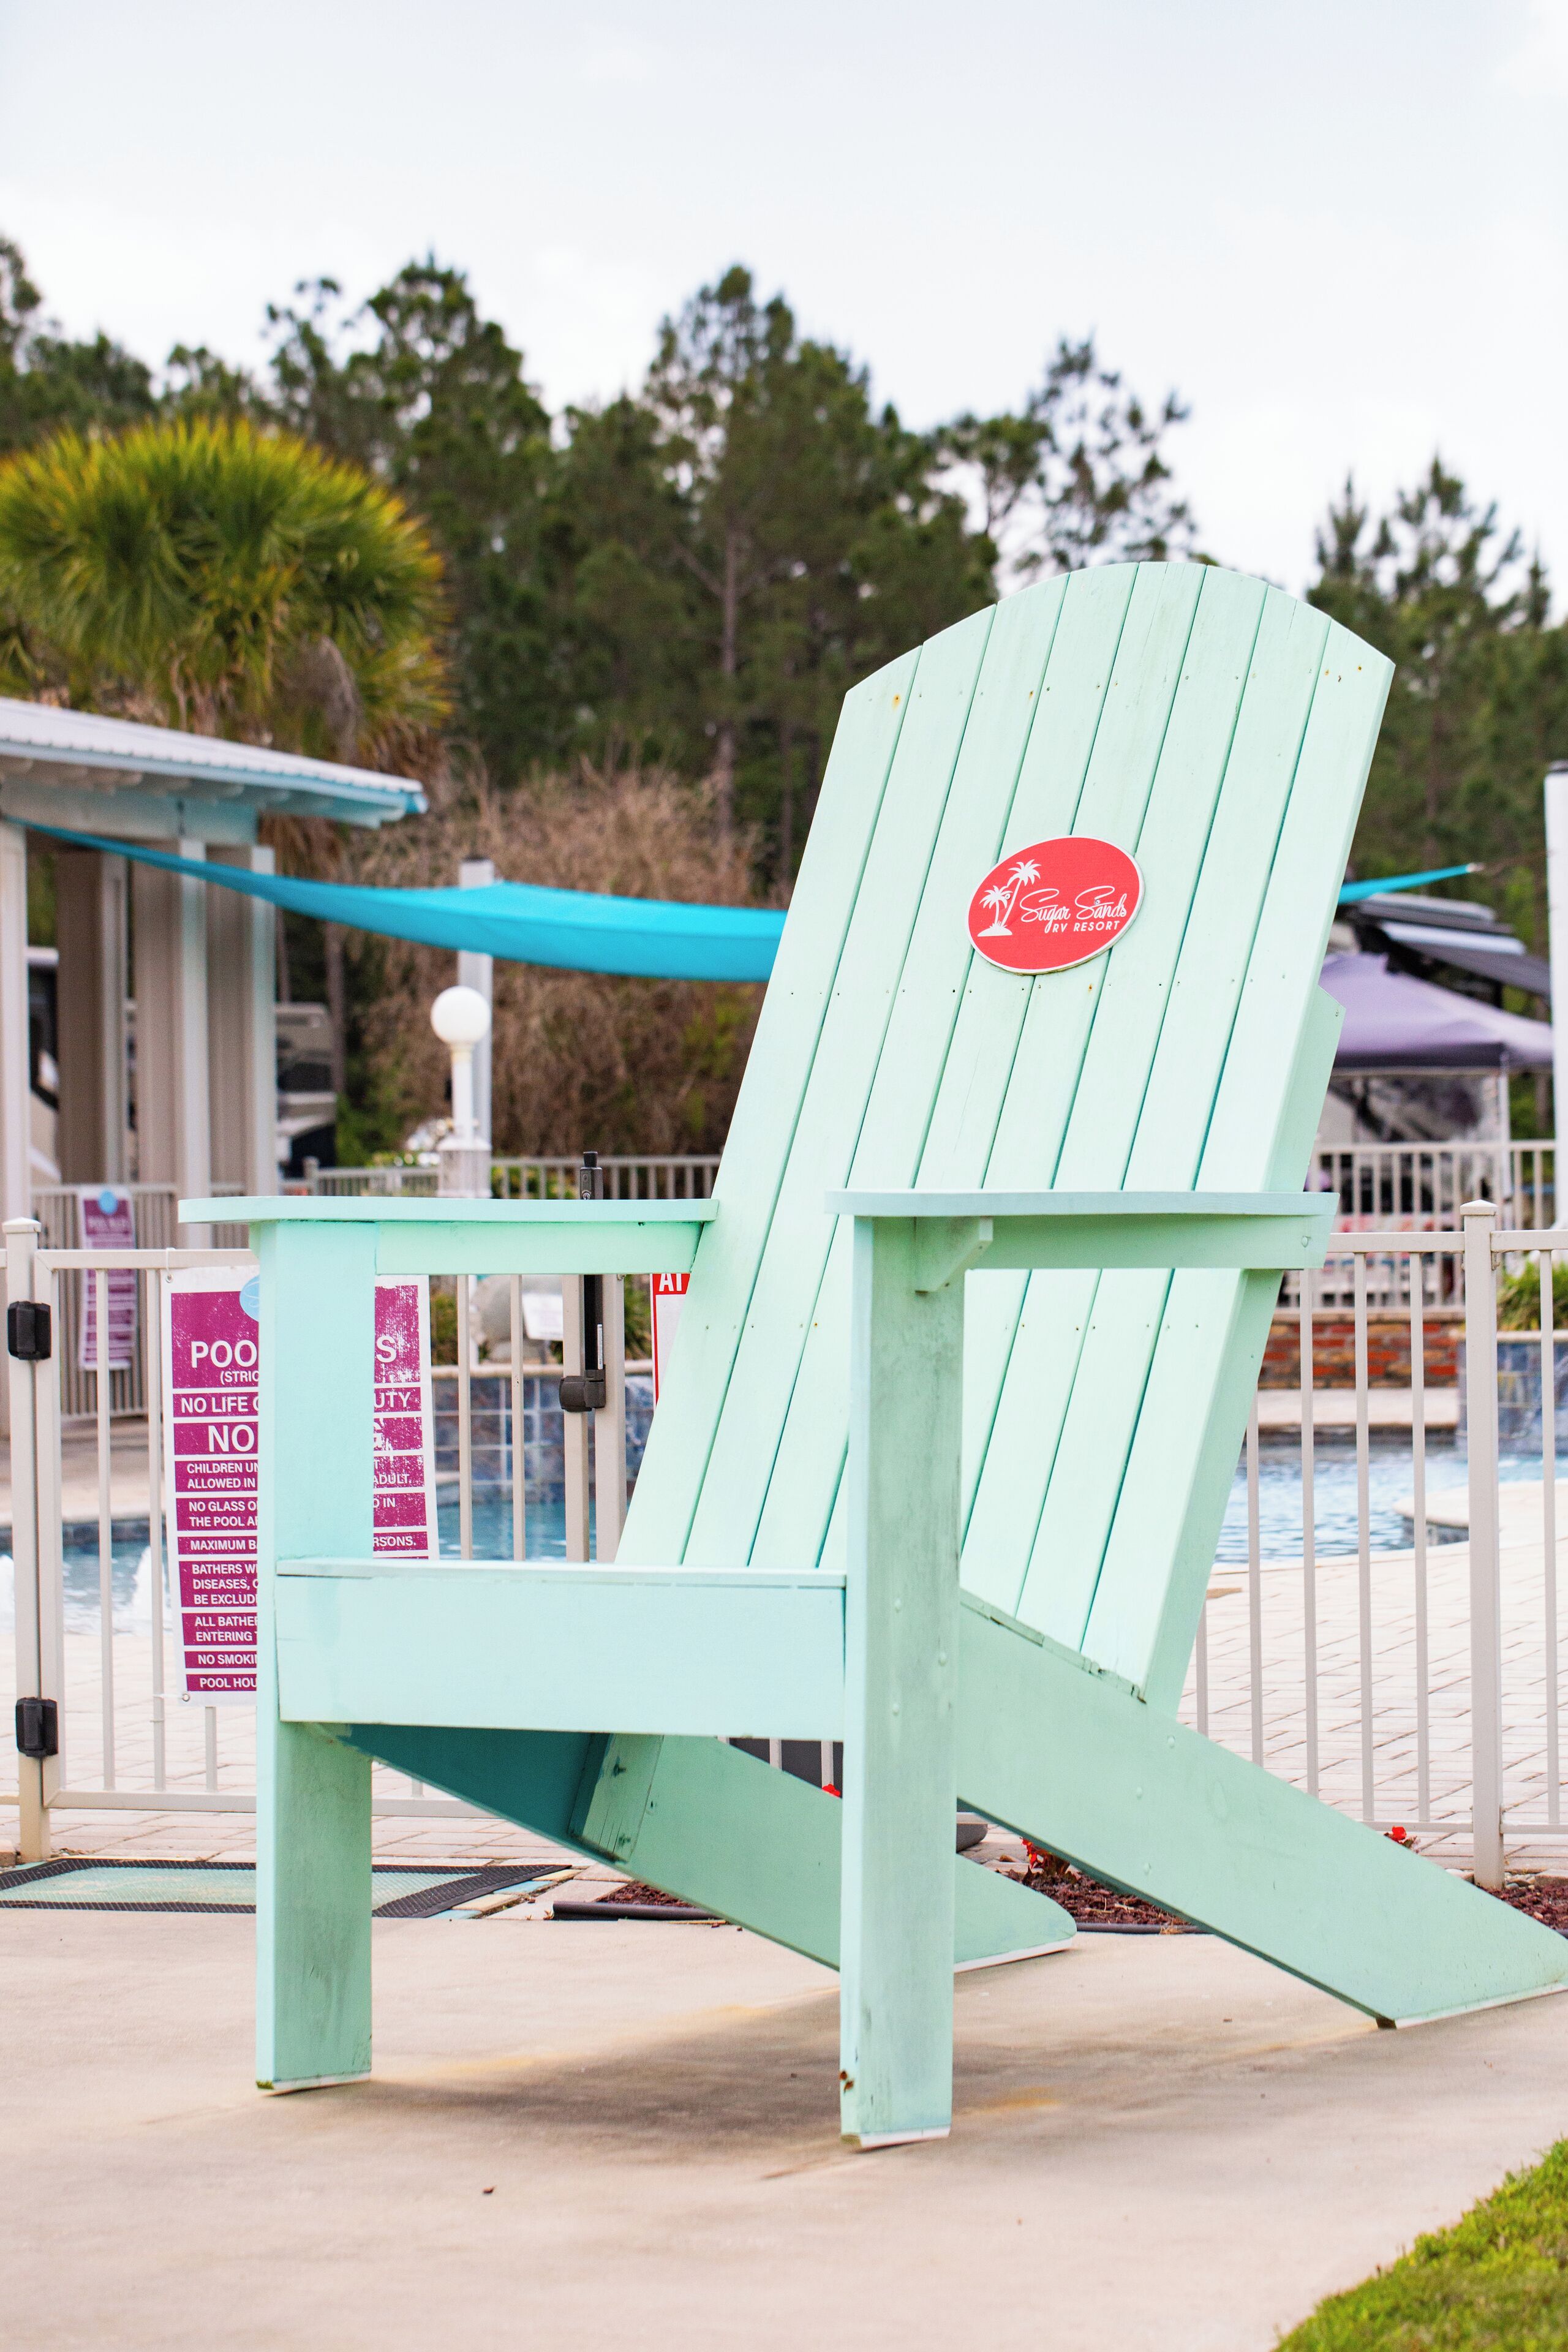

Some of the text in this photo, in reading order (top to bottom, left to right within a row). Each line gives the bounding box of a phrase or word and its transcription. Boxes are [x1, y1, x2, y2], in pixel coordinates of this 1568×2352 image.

[1020, 886, 1128, 933] Sugar Sands
[1052, 921, 1120, 933] RV RESORT
[181, 1397, 207, 1414] NO
[212, 1396, 248, 1412] LIFE
[208, 1424, 255, 1452] NO
[187, 1463, 242, 1474] CHILDREN
[187, 1478, 241, 1489] ALLOWED
[244, 1477, 255, 1488] IN
[189, 1502, 205, 1512] NO
[208, 1501, 245, 1511] GLASS
[383, 1498, 396, 1507] IN
[189, 1517, 211, 1526] THE
[214, 1516, 245, 1526] POOL
[190, 1540, 245, 1550] MAXIMUM
[192, 1564, 243, 1574] BATHERS
[193, 1579, 250, 1590] DISEASES,
[194, 1594, 257, 1604] BE EXCLUD
[195, 1616, 216, 1627] ALL
[196, 1631, 252, 1642] ENTERING
[198, 1654, 215, 1664] NO
[200, 1678, 231, 1687] POOL
